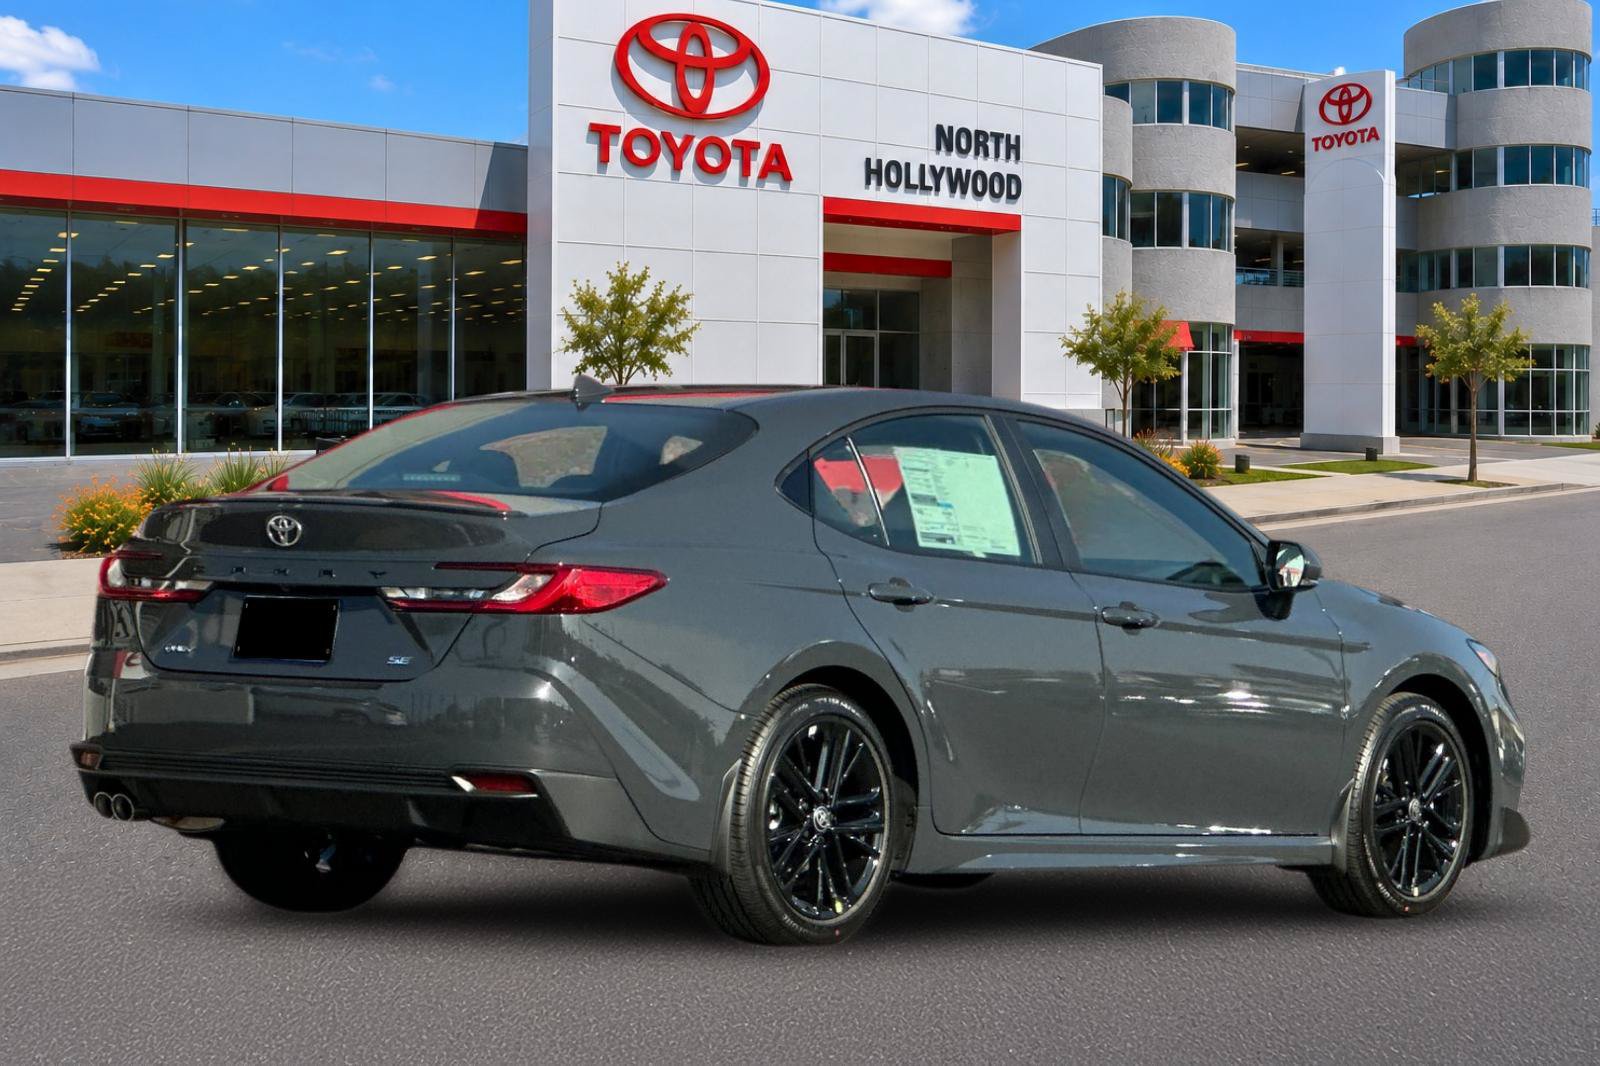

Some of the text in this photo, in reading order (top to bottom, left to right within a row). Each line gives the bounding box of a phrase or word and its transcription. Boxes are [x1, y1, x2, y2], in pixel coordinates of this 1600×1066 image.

[588, 122, 793, 181] TOYOTA
[935, 124, 1021, 161] NORTH
[1311, 126, 1380, 152] TOYOTA
[865, 157, 1022, 200] HOLLYWOOD
